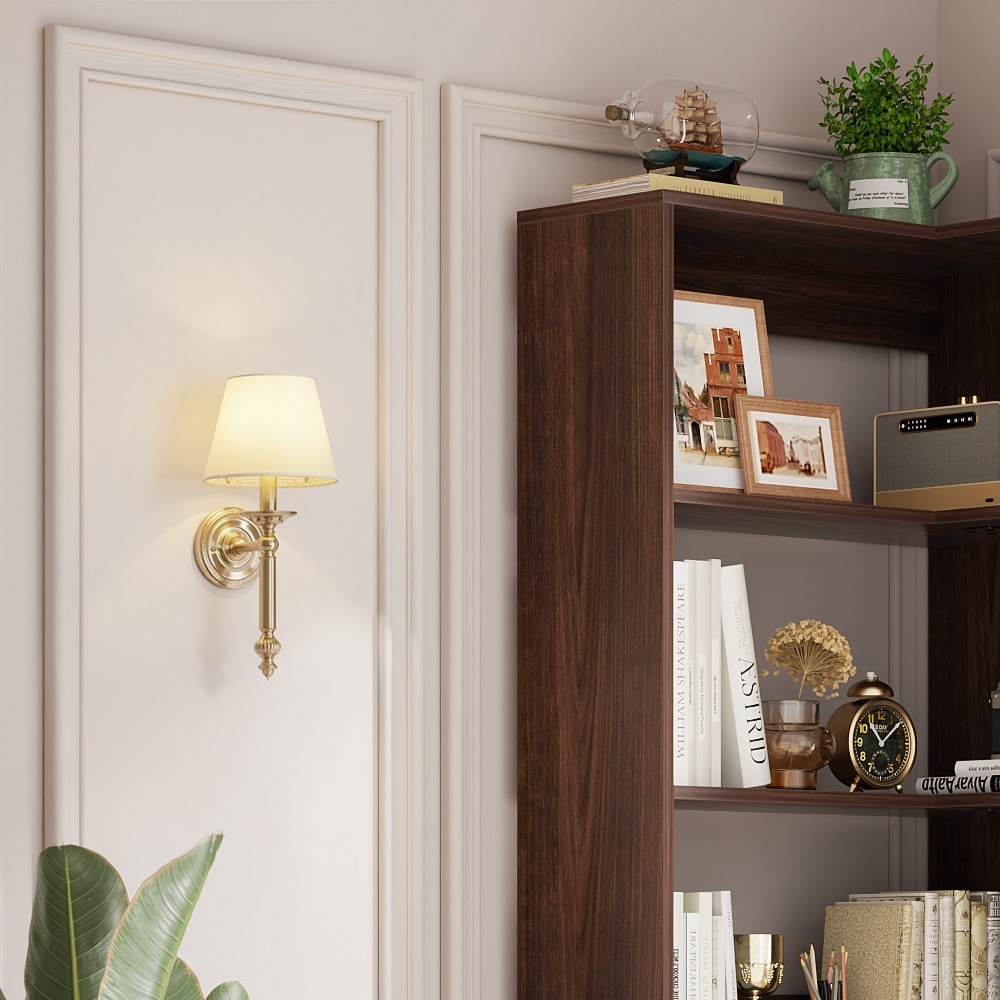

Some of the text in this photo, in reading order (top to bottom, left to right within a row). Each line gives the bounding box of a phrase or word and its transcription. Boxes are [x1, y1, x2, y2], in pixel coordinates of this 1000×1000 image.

[677, 584, 685, 758] WILLIAM SHAKESPEARE
[868, 714, 874, 724] 11
[878, 711, 886, 720] 12
[860, 724, 868, 734] 10
[857, 738, 863, 747] 9
[860, 752, 901, 763] 8 4
[868, 762, 894, 773] 7 5
